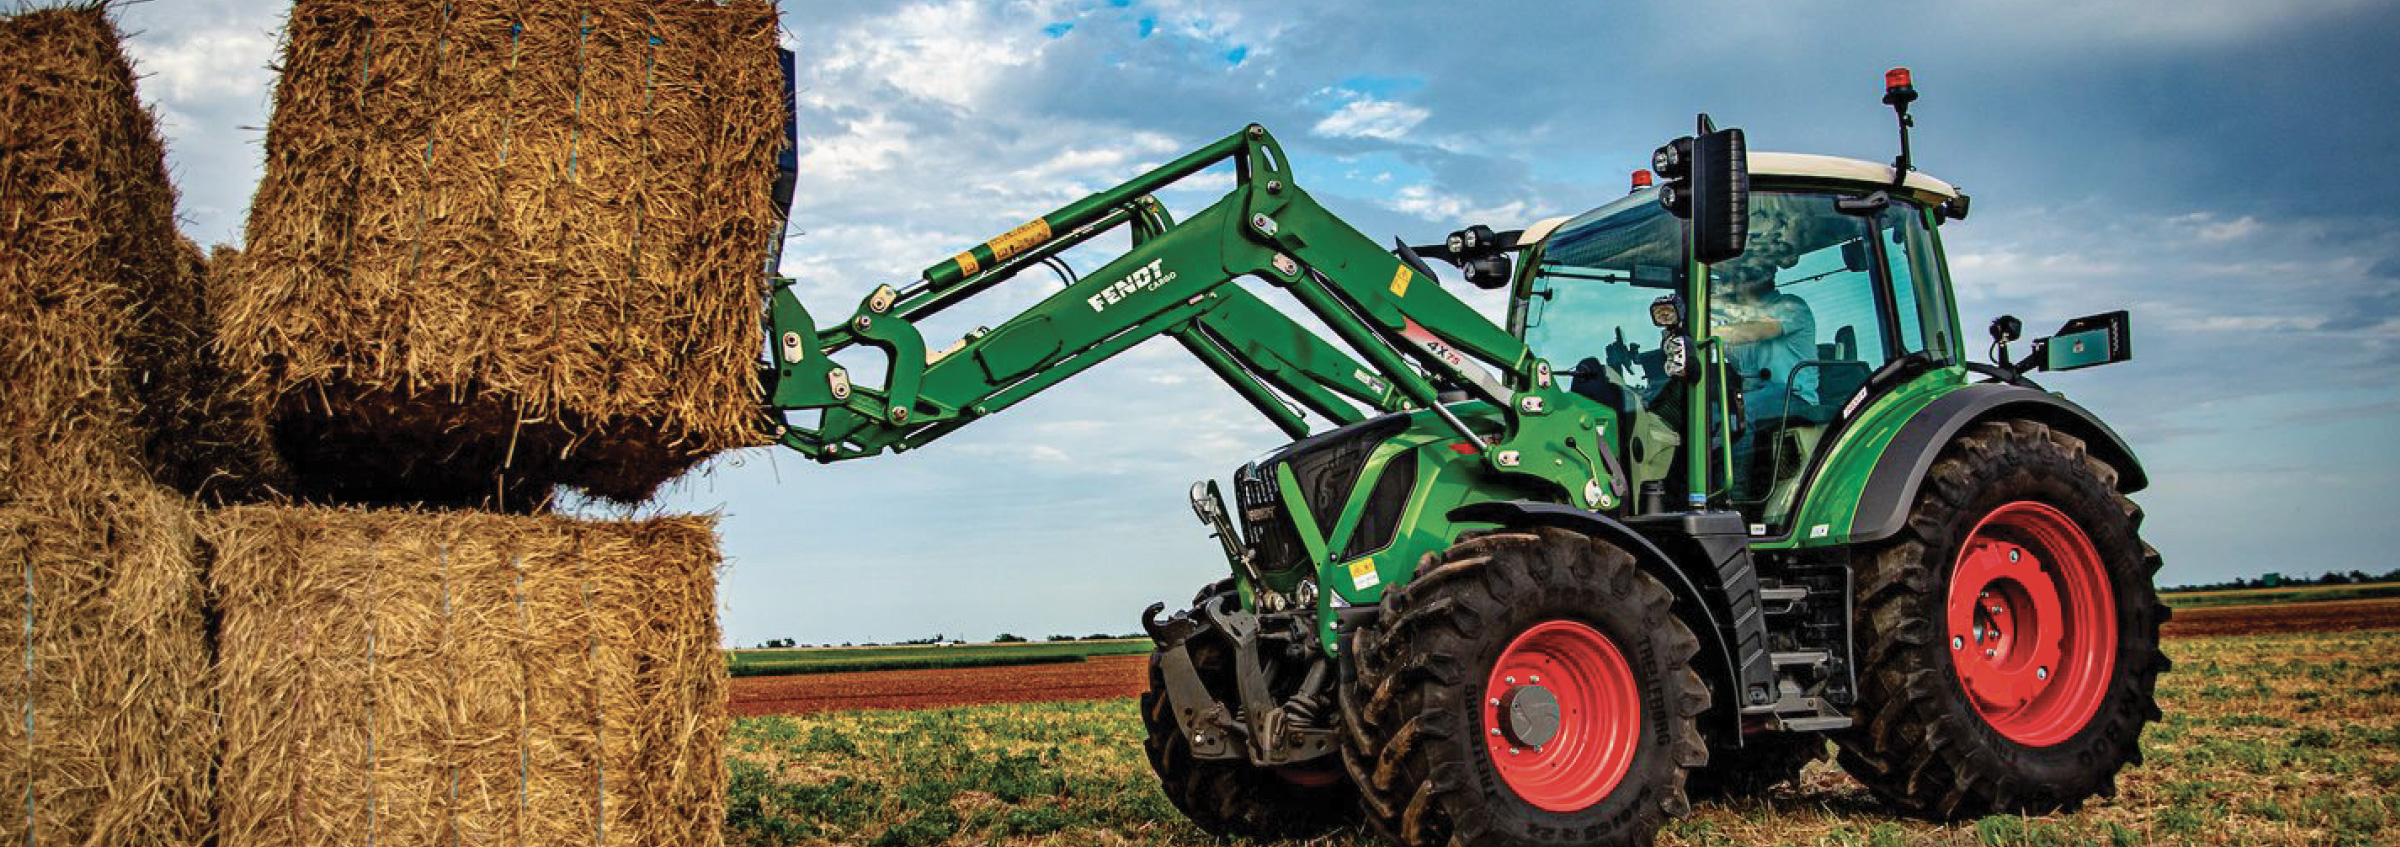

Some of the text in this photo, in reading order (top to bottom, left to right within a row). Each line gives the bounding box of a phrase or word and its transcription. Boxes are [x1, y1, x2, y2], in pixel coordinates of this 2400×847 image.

[1087, 258, 1162, 313] FENDT
[1147, 271, 1177, 291] CARGO
[1638, 635, 1670, 746] TRELLEBORG
